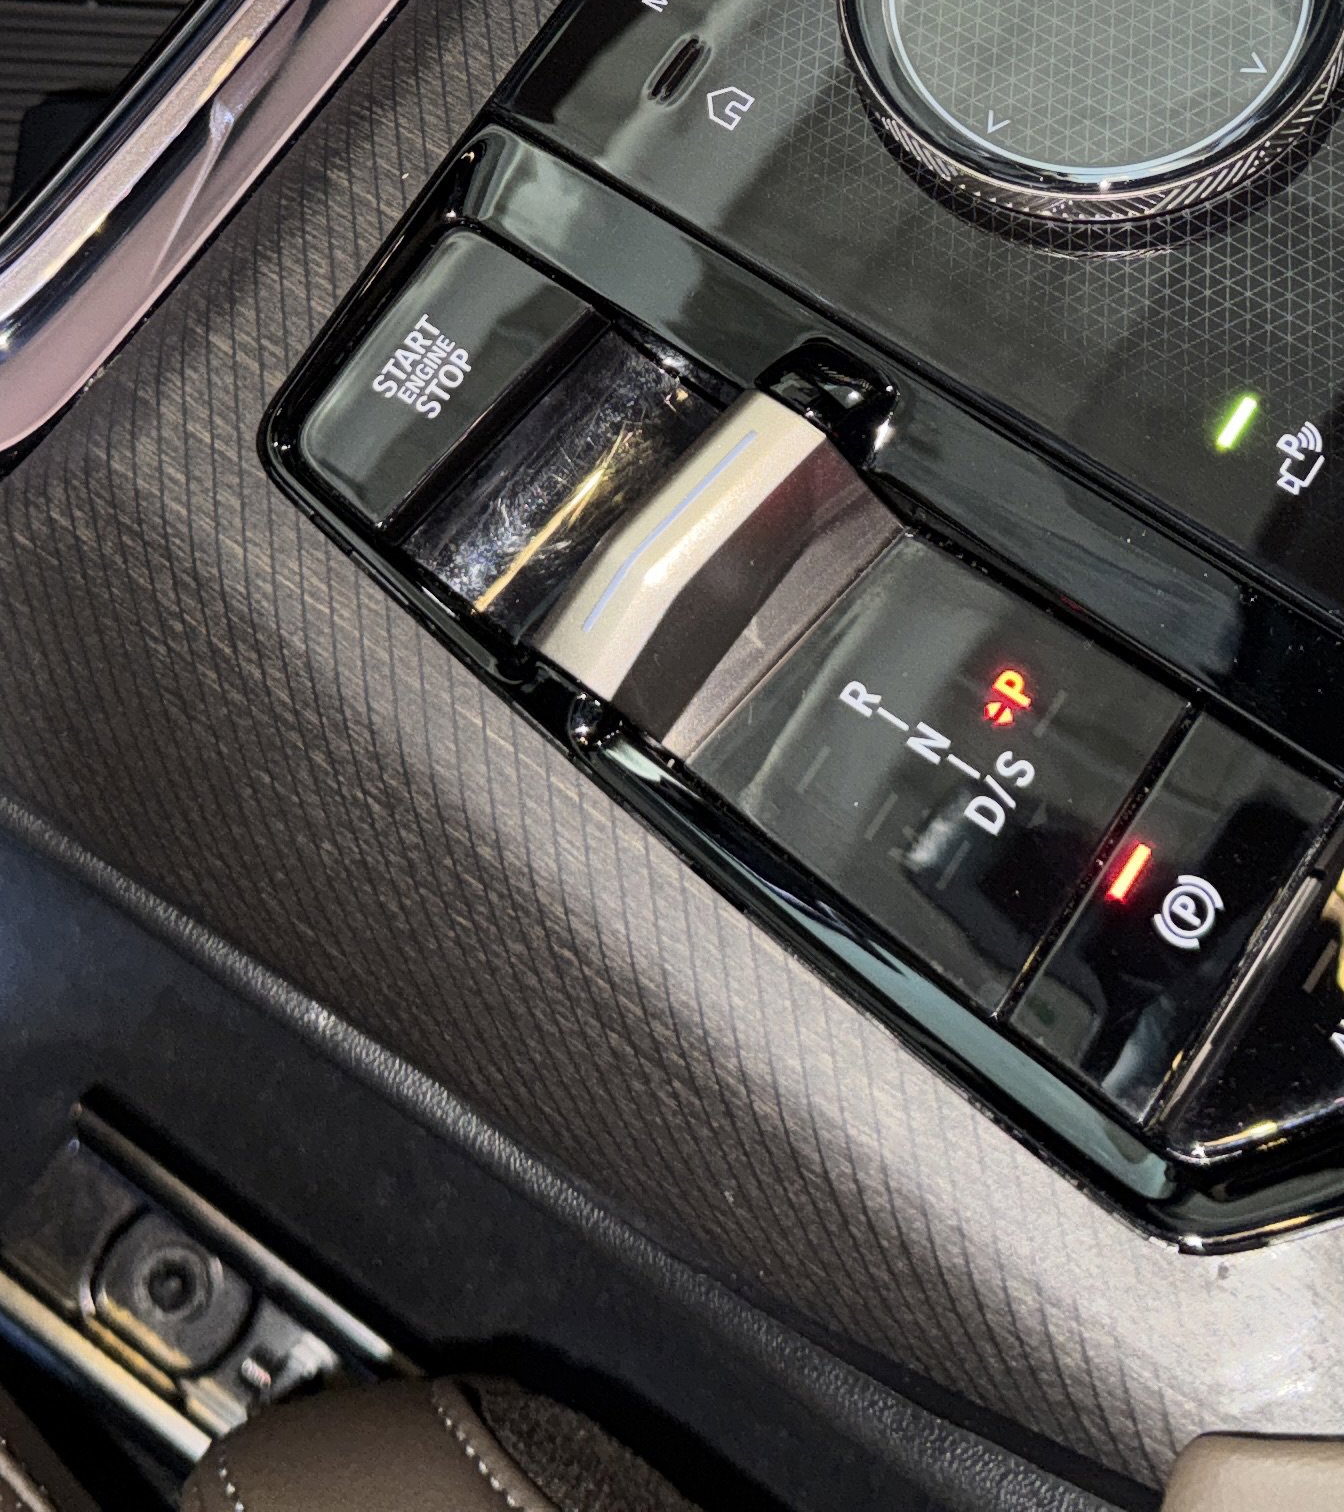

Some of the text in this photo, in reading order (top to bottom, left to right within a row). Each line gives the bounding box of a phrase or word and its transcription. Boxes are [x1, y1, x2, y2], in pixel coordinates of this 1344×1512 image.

[373, 314, 442, 398] START
[398, 334, 455, 405] ENGINE
[417, 347, 472, 419] STOP
[839, 678, 881, 718] R
[992, 668, 1032, 709] P
[906, 721, 951, 765] N
[964, 750, 1036, 836] D/S
